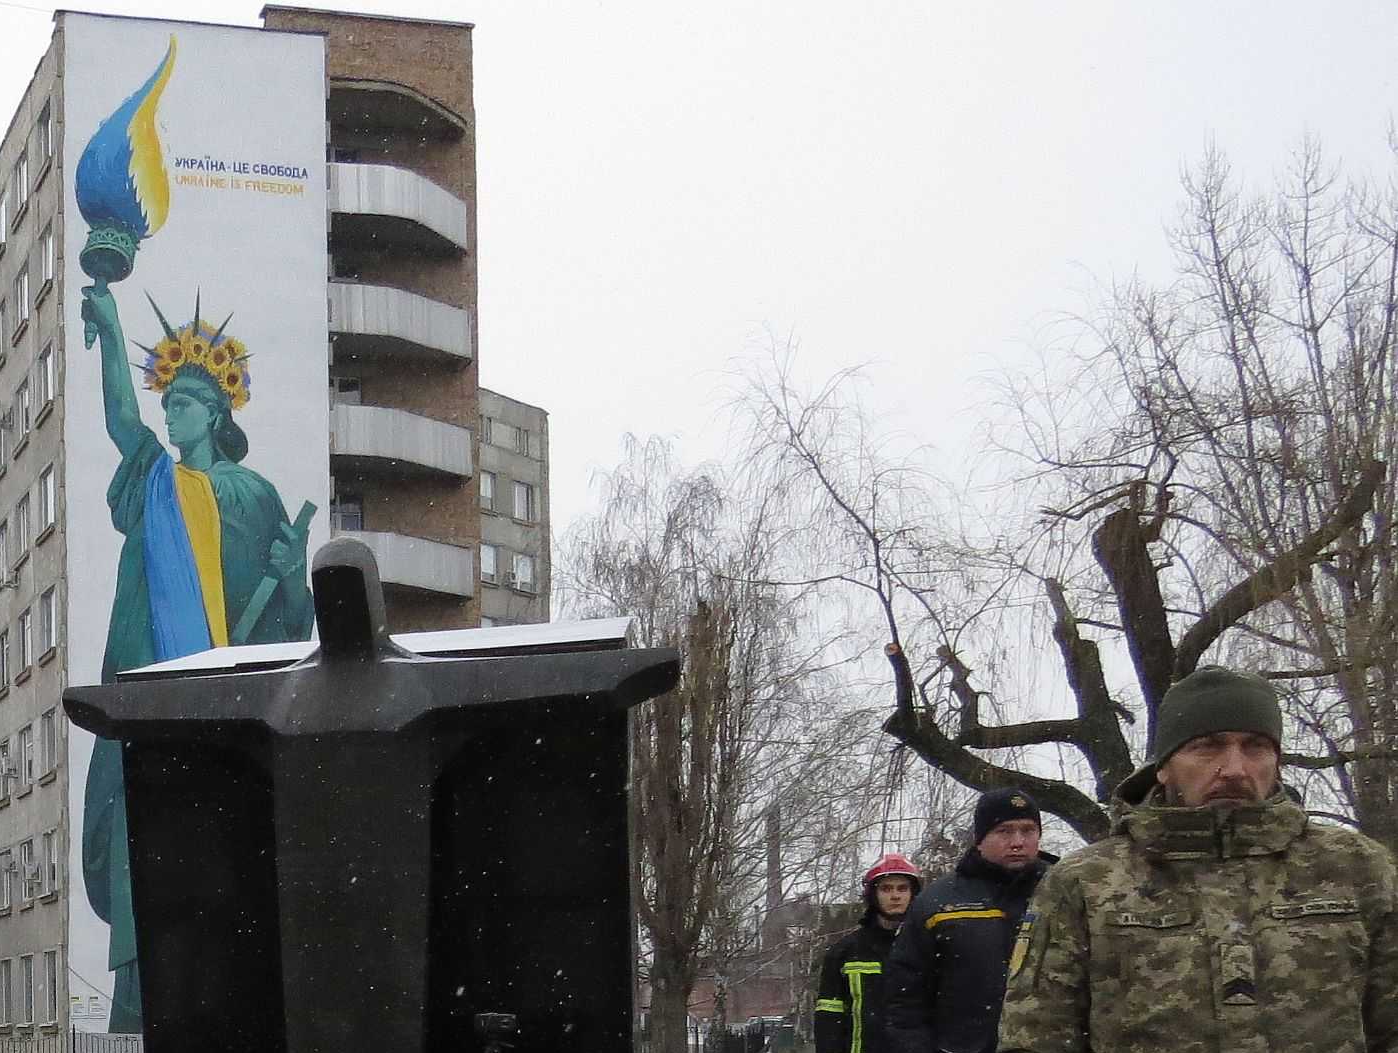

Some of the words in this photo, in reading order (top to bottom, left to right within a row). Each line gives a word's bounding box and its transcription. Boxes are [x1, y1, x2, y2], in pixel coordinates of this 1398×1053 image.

[175, 155, 226, 172] УКРАЇНА
[233, 162, 250, 174] ЦЕ
[253, 163, 308, 180] СВОБОДА
[245, 180, 304, 195] FREEDOM
